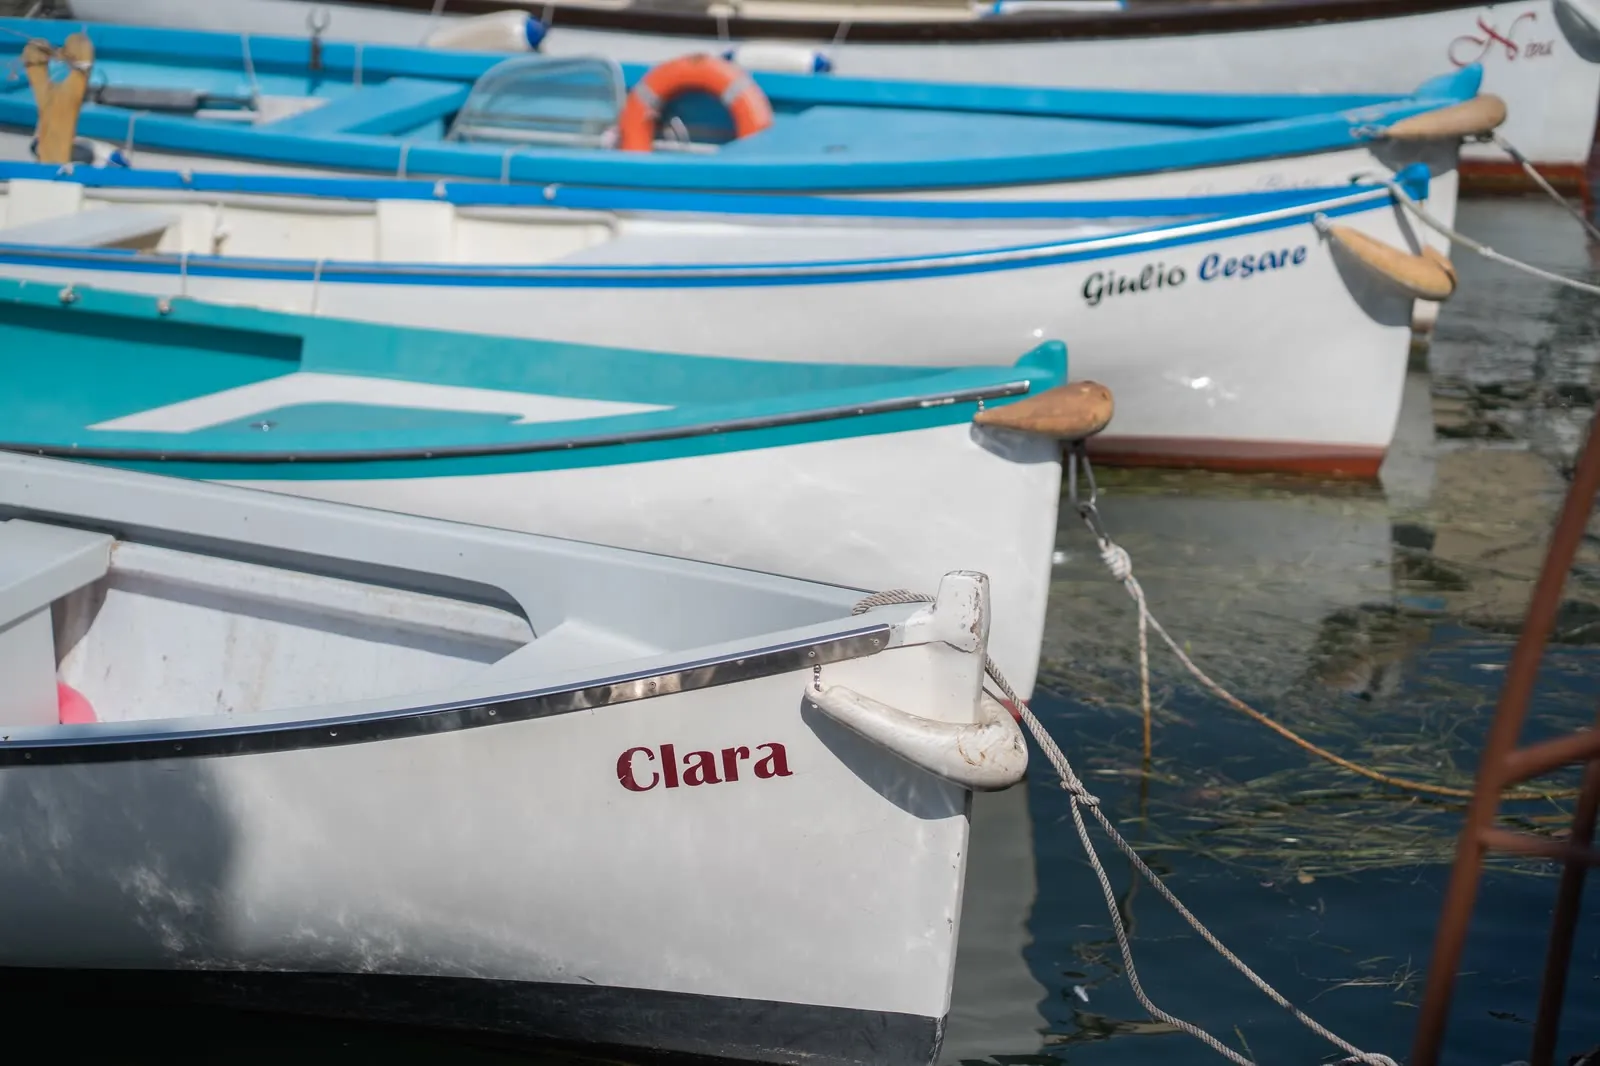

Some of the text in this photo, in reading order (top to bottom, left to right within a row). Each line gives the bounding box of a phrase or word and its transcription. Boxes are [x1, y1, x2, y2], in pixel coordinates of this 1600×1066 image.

[1082, 244, 1307, 307] Giulio Cesare
[616, 742, 793, 792] Clara
